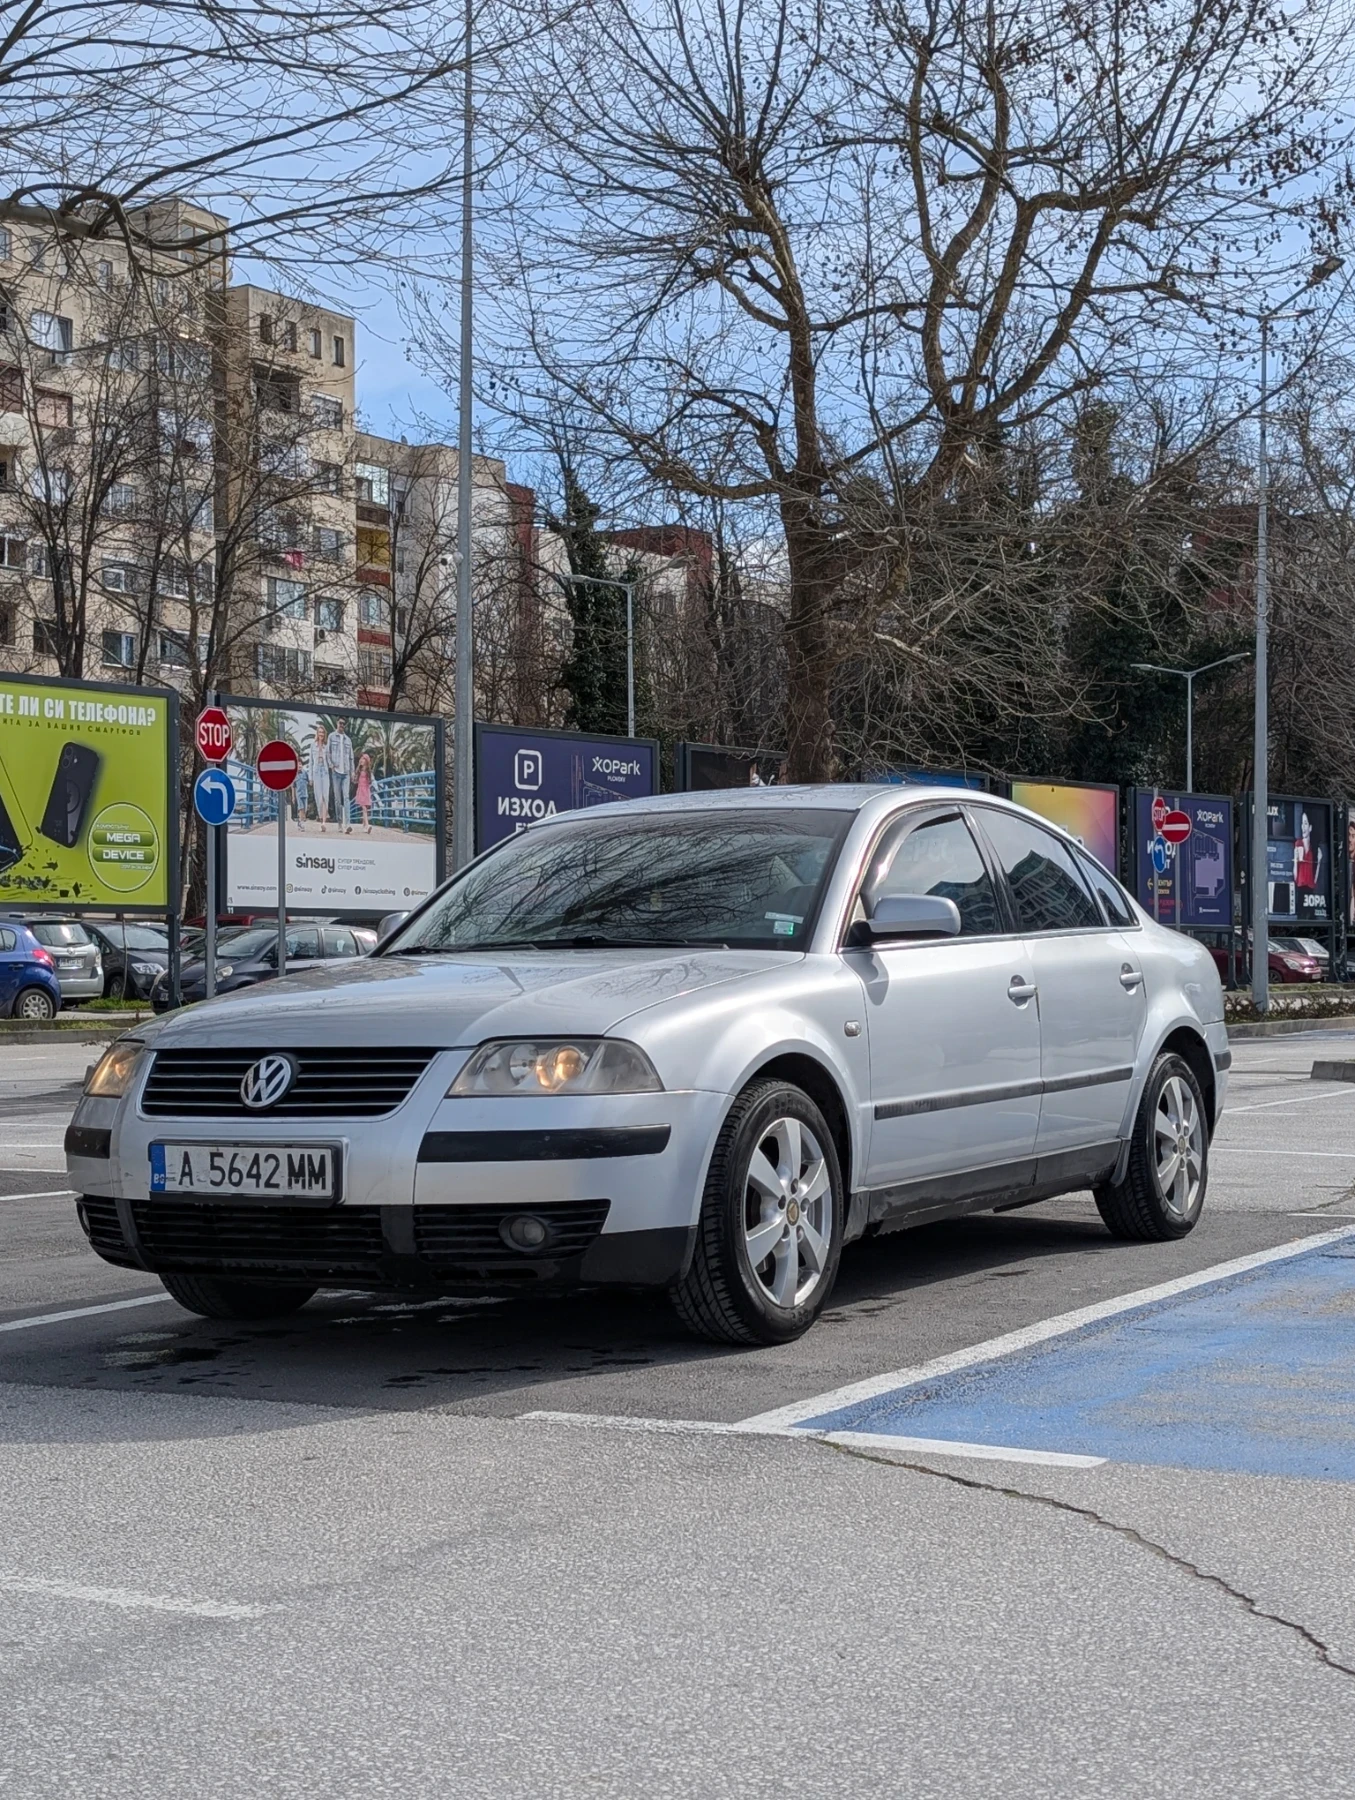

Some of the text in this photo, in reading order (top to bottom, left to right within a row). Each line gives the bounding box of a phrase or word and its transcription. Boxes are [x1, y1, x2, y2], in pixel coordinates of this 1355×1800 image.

[18, 695, 39, 717] ЛИ
[44, 698, 64, 719] СИ
[69, 700, 156, 726] ТЕЛЕФОНА?
[200, 722, 231, 747] STOP
[497, 796, 557, 819] ИЗХОД
[1154, 806, 1165, 822] STOP
[107, 832, 141, 843] MEGA
[103, 849, 145, 860] DEVICE
[295, 853, 335, 874] sinsay
[1303, 895, 1327, 907] ЗОРА
[178, 1151, 327, 1190] A 5642 MM
